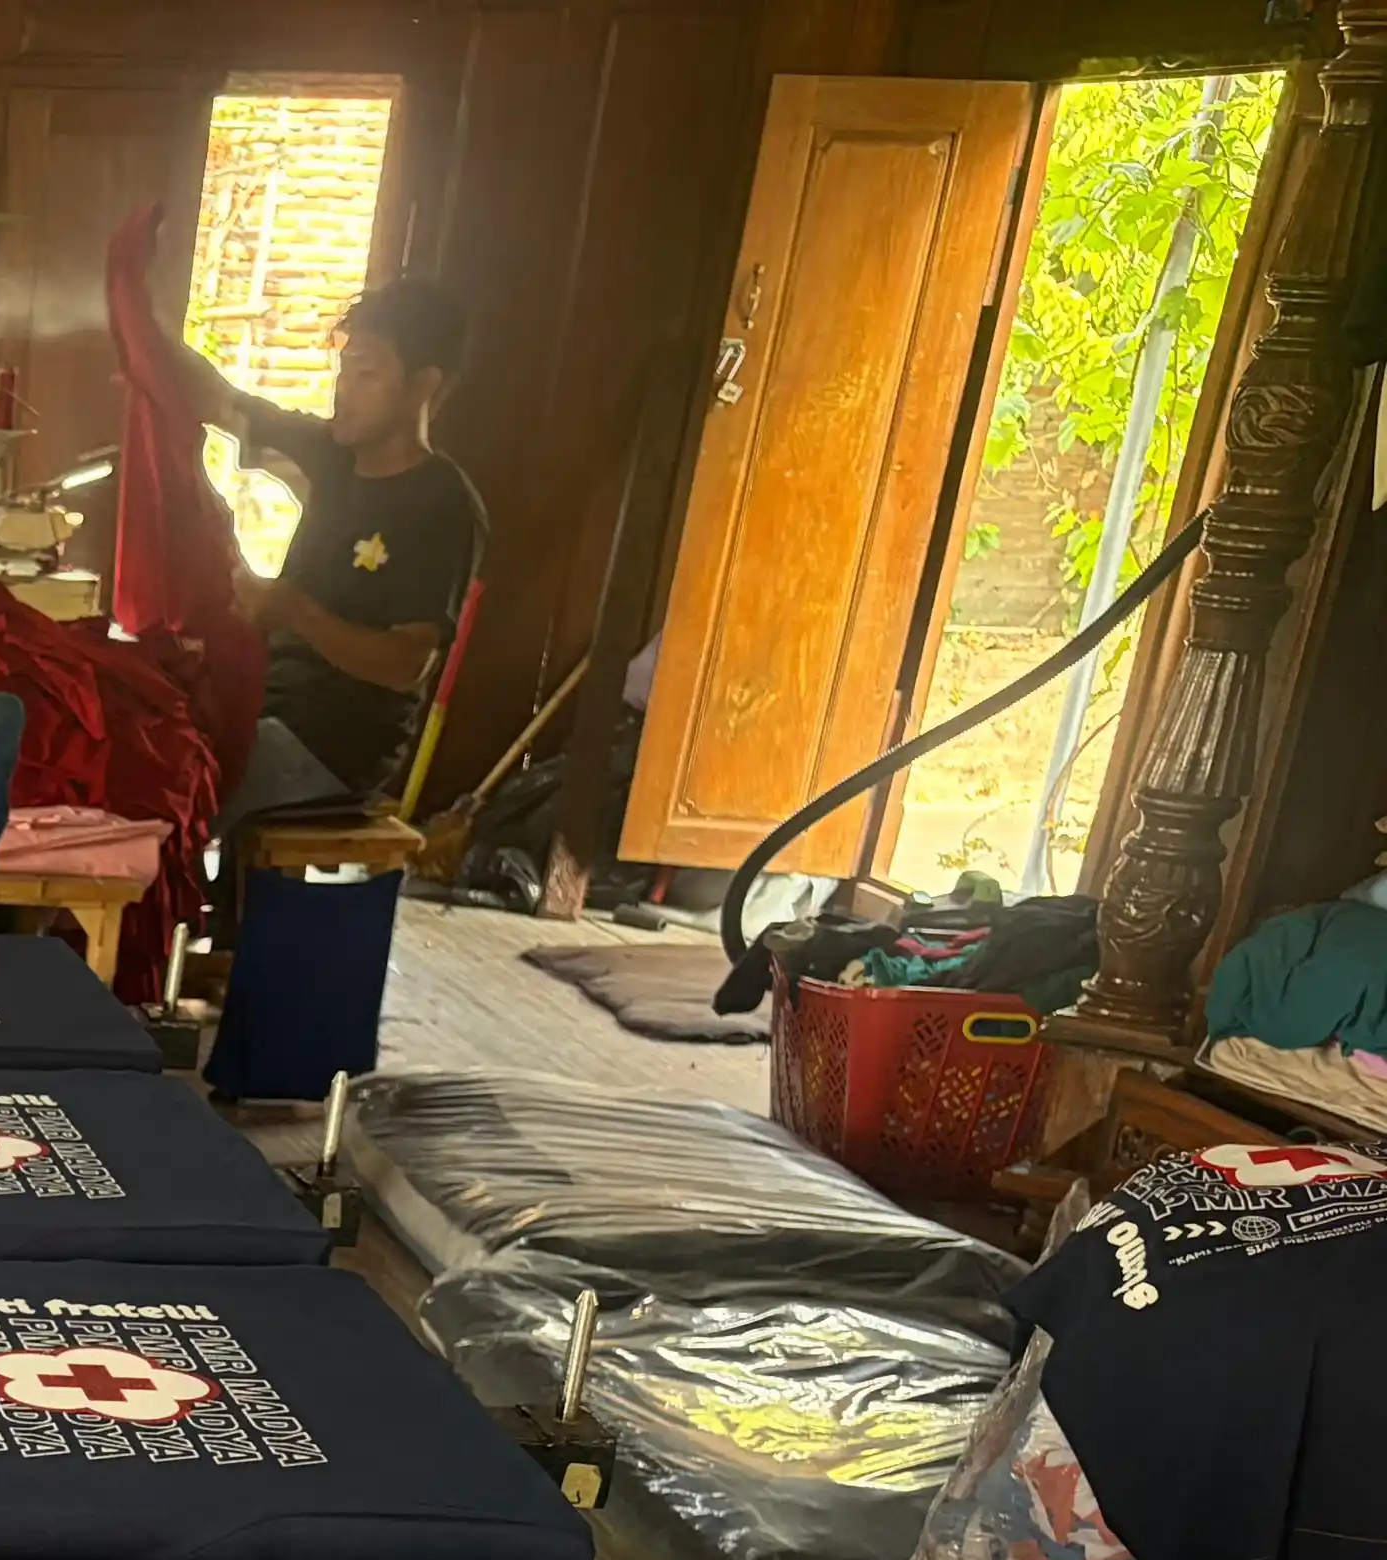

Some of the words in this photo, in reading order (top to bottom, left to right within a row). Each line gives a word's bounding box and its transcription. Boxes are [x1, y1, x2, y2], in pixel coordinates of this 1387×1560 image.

[42, 1299, 219, 1320] fratelli
[7, 1318, 69, 1350] PM
[64, 1320, 129, 1350] PM
[179, 1324, 257, 1373] PMR
[218, 1378, 328, 1467] MADYA
